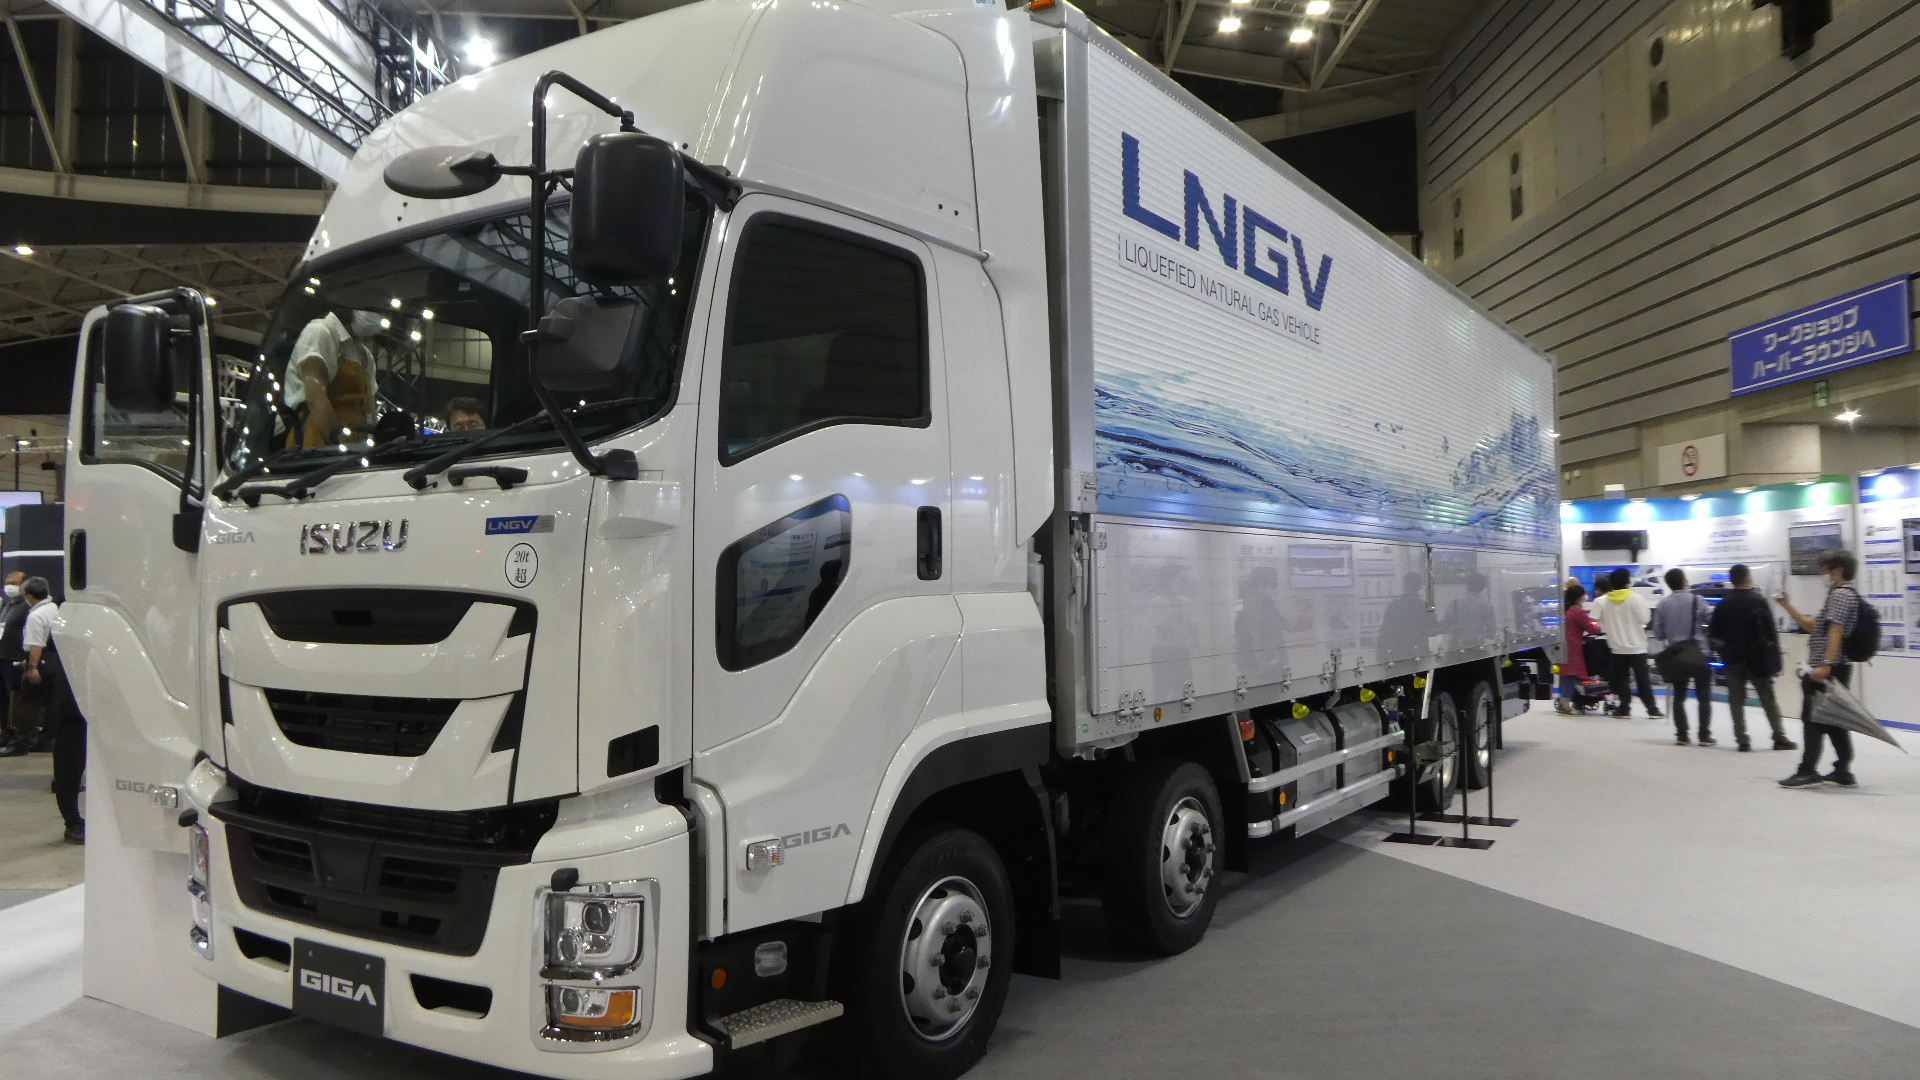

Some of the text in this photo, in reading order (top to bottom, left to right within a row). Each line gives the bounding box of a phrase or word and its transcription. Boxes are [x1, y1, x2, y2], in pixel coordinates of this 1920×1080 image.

[1122, 131, 1333, 311] LNGV
[1125, 239, 1320, 344] LIQUEFIED NATURAL GAS VEHICLE
[1763, 305, 1860, 352] ワークショップ
[216, 531, 255, 544] GIGA
[300, 518, 409, 554] ISUZU
[488, 520, 532, 530] LNGV
[514, 550, 530, 563] 20t
[514, 567, 527, 583] 超
[781, 823, 852, 849] GIGA
[300, 968, 377, 1006] GIGA
